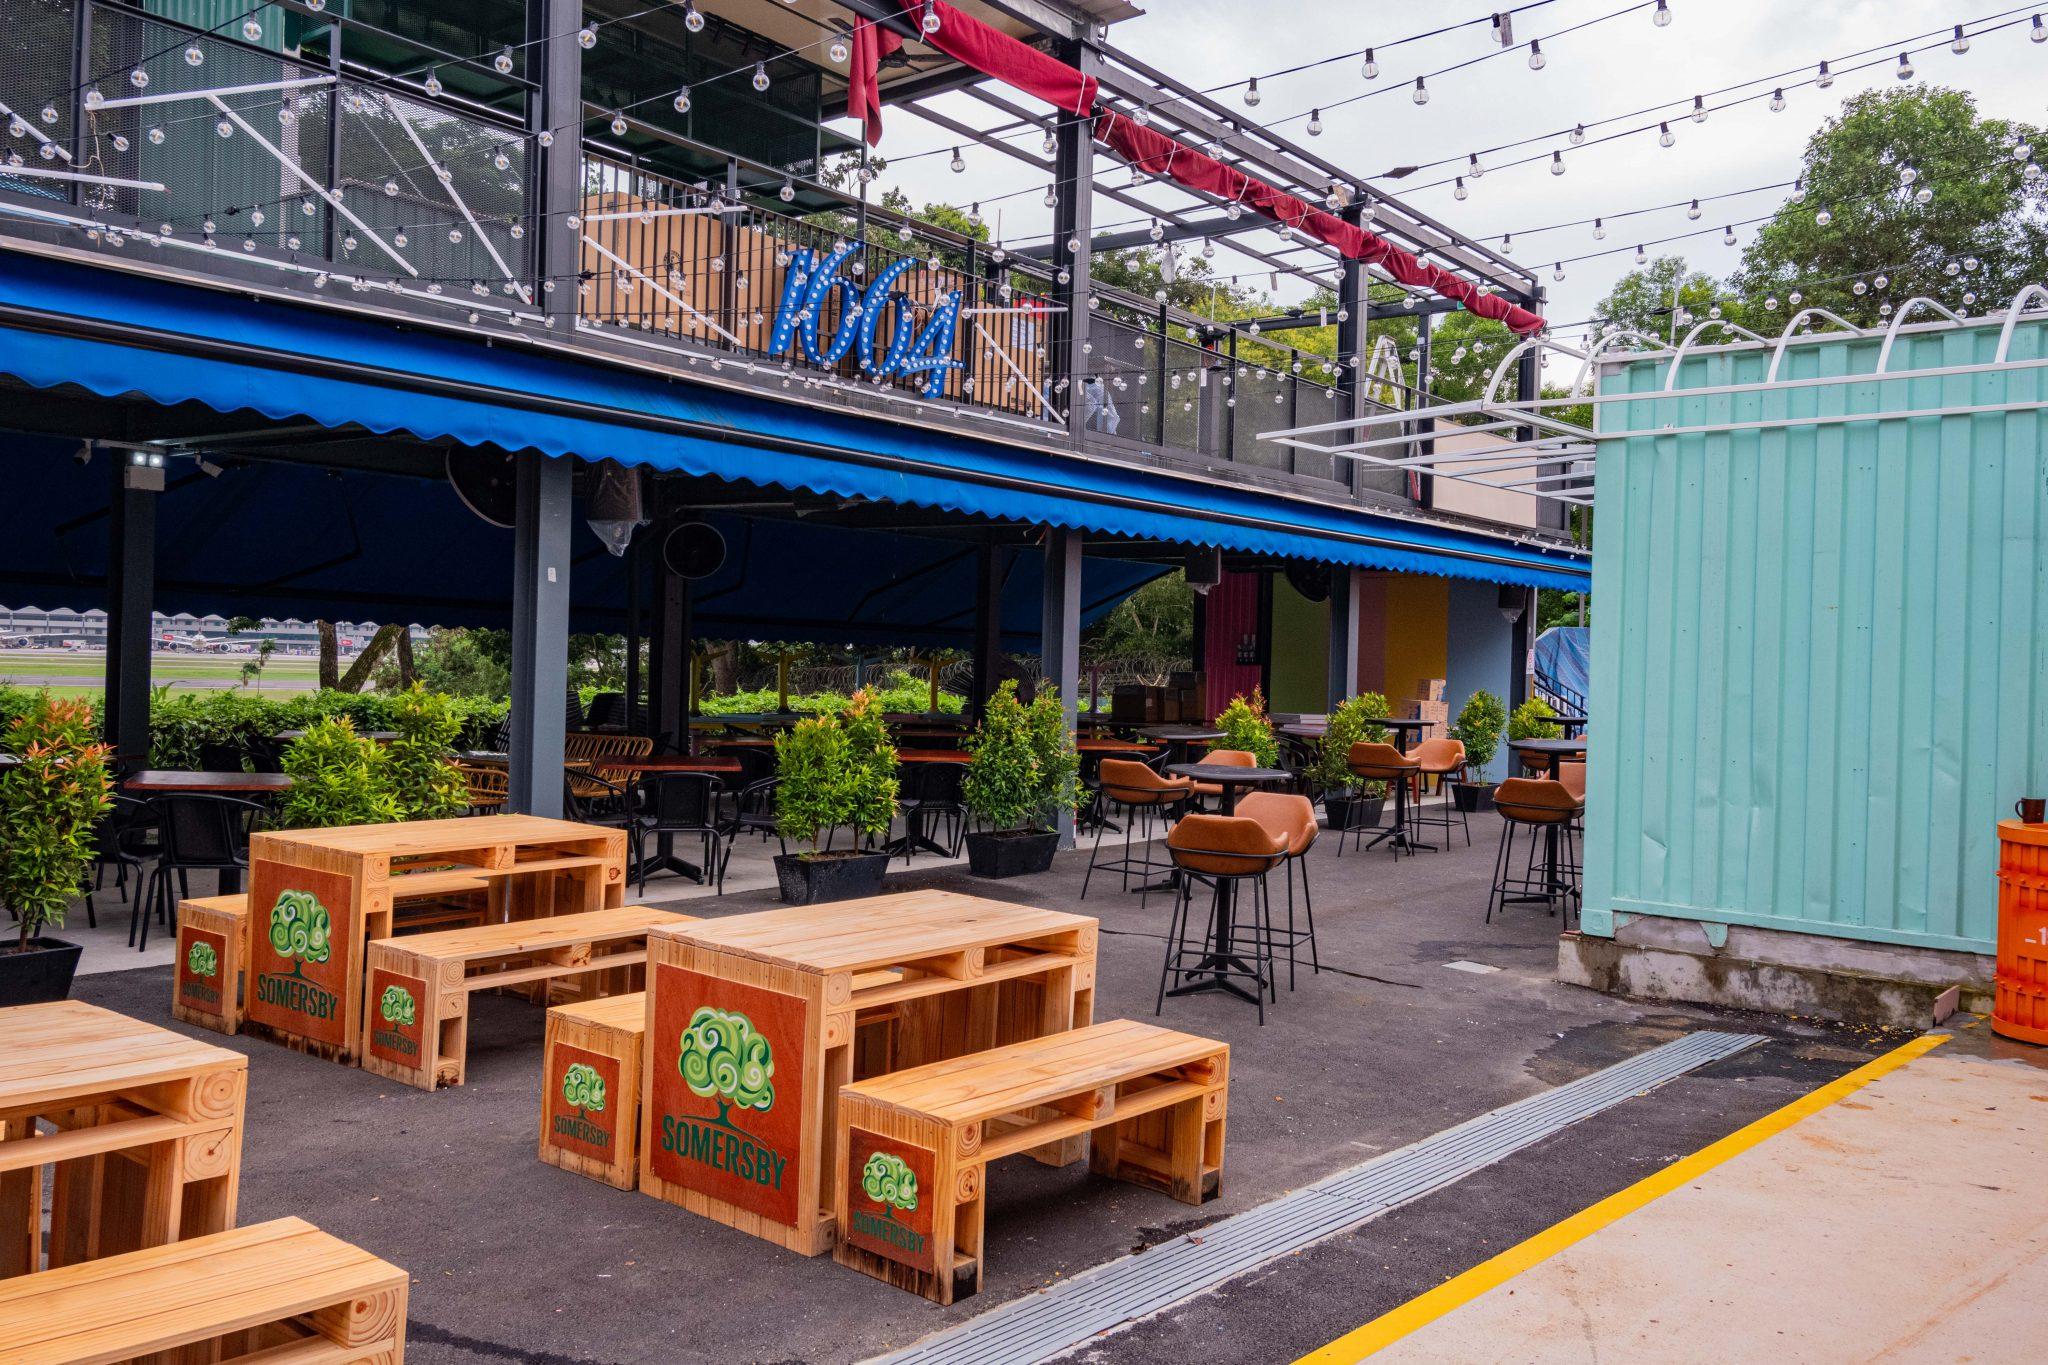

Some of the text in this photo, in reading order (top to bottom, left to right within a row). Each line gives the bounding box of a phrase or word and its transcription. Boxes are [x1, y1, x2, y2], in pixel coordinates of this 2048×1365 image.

[768, 240, 966, 399] 1664
[257, 973, 338, 1021] SOMERSBY
[374, 1029, 419, 1057] SOMERSBY
[554, 1114, 611, 1148] SOMERSBY
[661, 1114, 787, 1191] SOMERSBY
[853, 1209, 925, 1255] SOMERSBY
